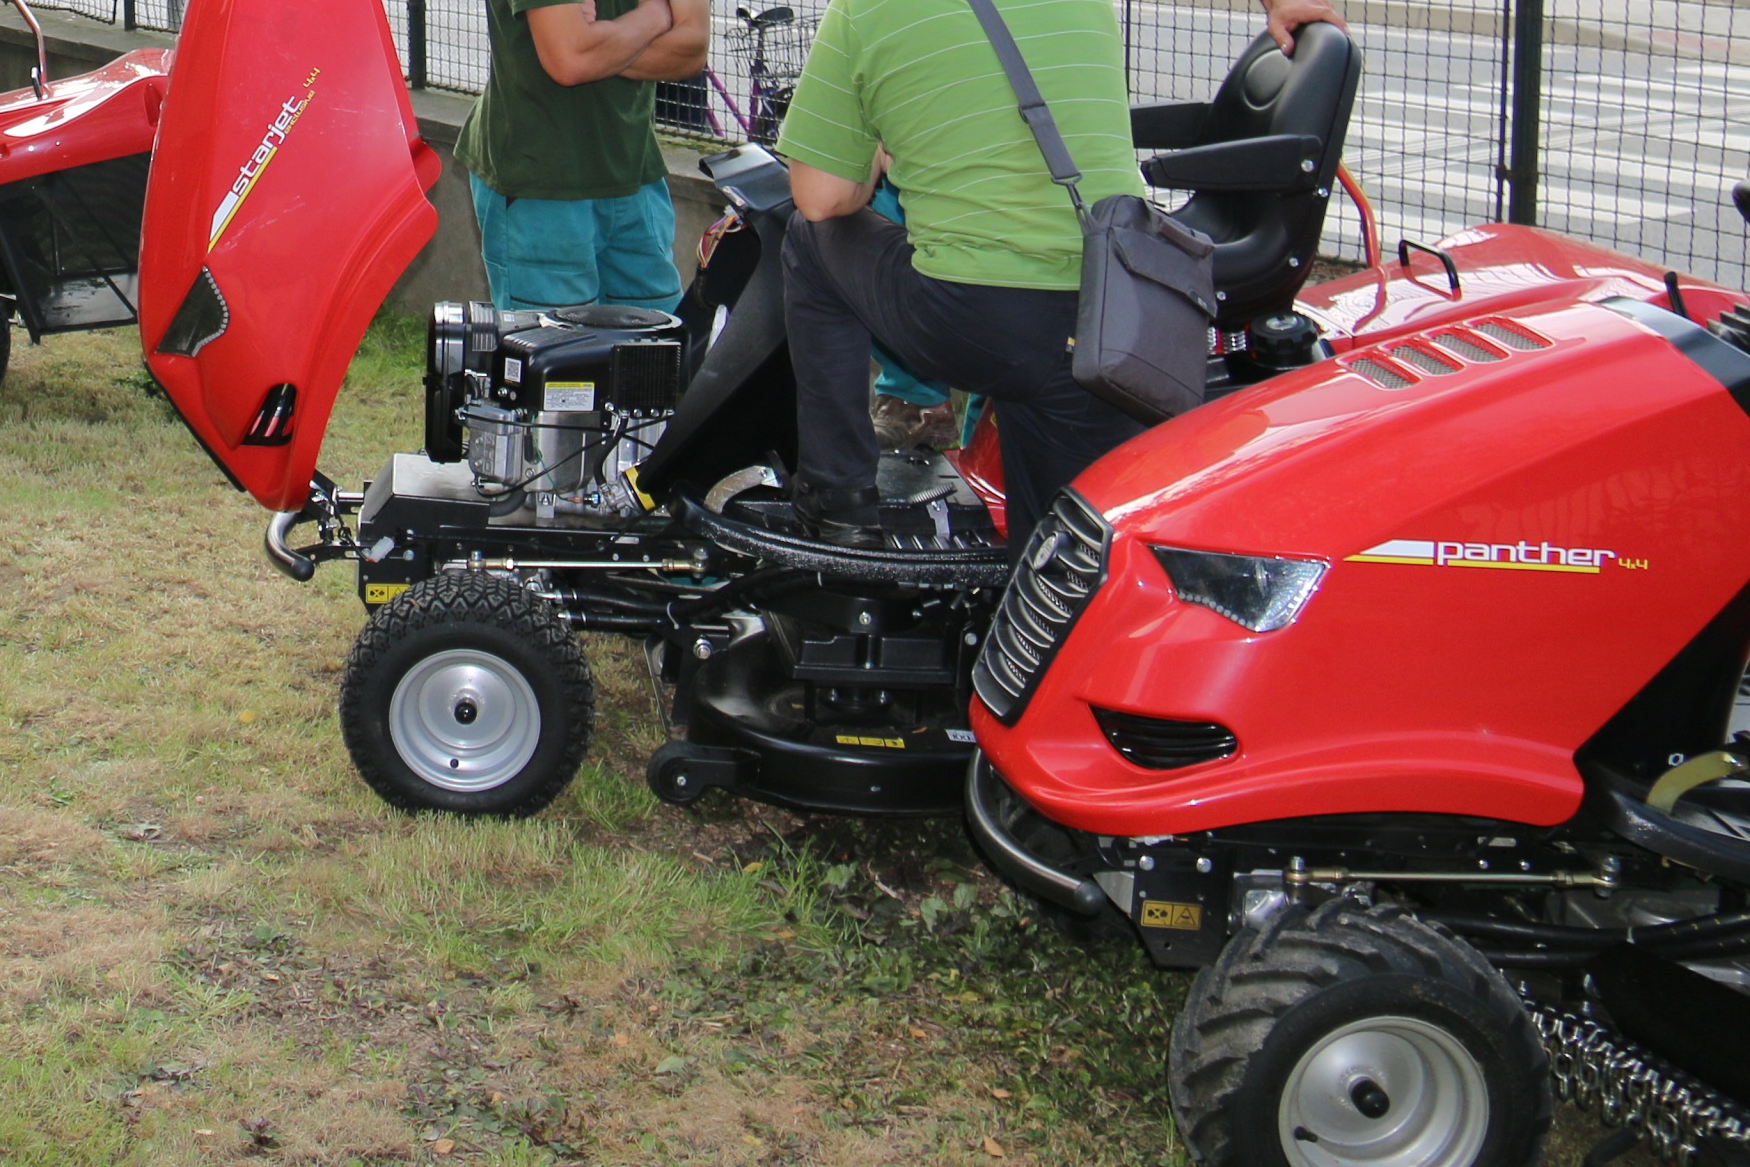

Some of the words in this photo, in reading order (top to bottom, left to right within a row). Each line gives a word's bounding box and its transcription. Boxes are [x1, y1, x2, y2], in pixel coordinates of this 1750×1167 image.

[303, 66, 321, 89] 4x4
[232, 95, 304, 196] starjet
[1436, 540, 1616, 567] panther
[1618, 557, 1648, 570] 4x4
